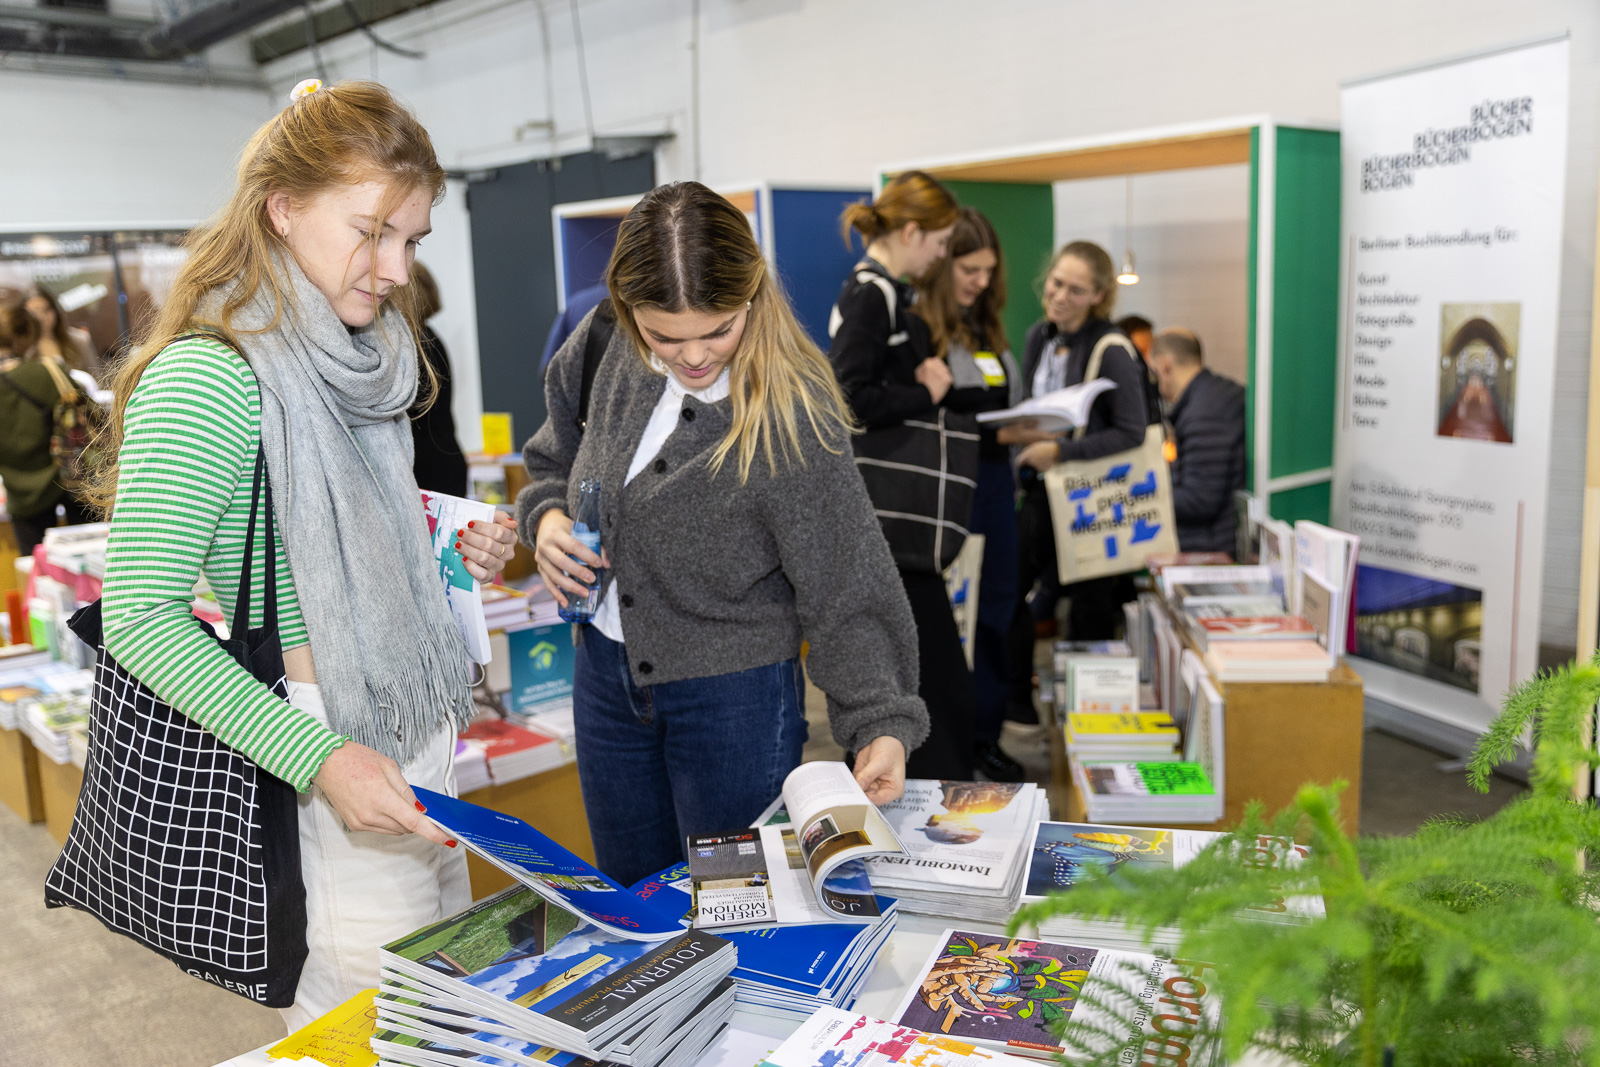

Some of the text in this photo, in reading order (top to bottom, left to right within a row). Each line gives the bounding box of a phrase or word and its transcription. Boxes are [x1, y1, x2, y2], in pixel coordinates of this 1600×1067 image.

[1471, 96, 1532, 122] BÜCHER
[1413, 115, 1532, 151] BÜCHERBOGEN
[1361, 146, 1471, 177] BÜCHERBOGEN
[1360, 171, 1414, 193] BOGEN
[701, 902, 766, 916] MOTION
[714, 908, 767, 922] GREEN
[633, 937, 693, 975] ARCHITEKTUR
[186, 968, 268, 1001] GALERIE
[602, 941, 705, 1002] JOURNAL
[611, 973, 631, 988] UND
[564, 986, 612, 1016] PLANUNG
